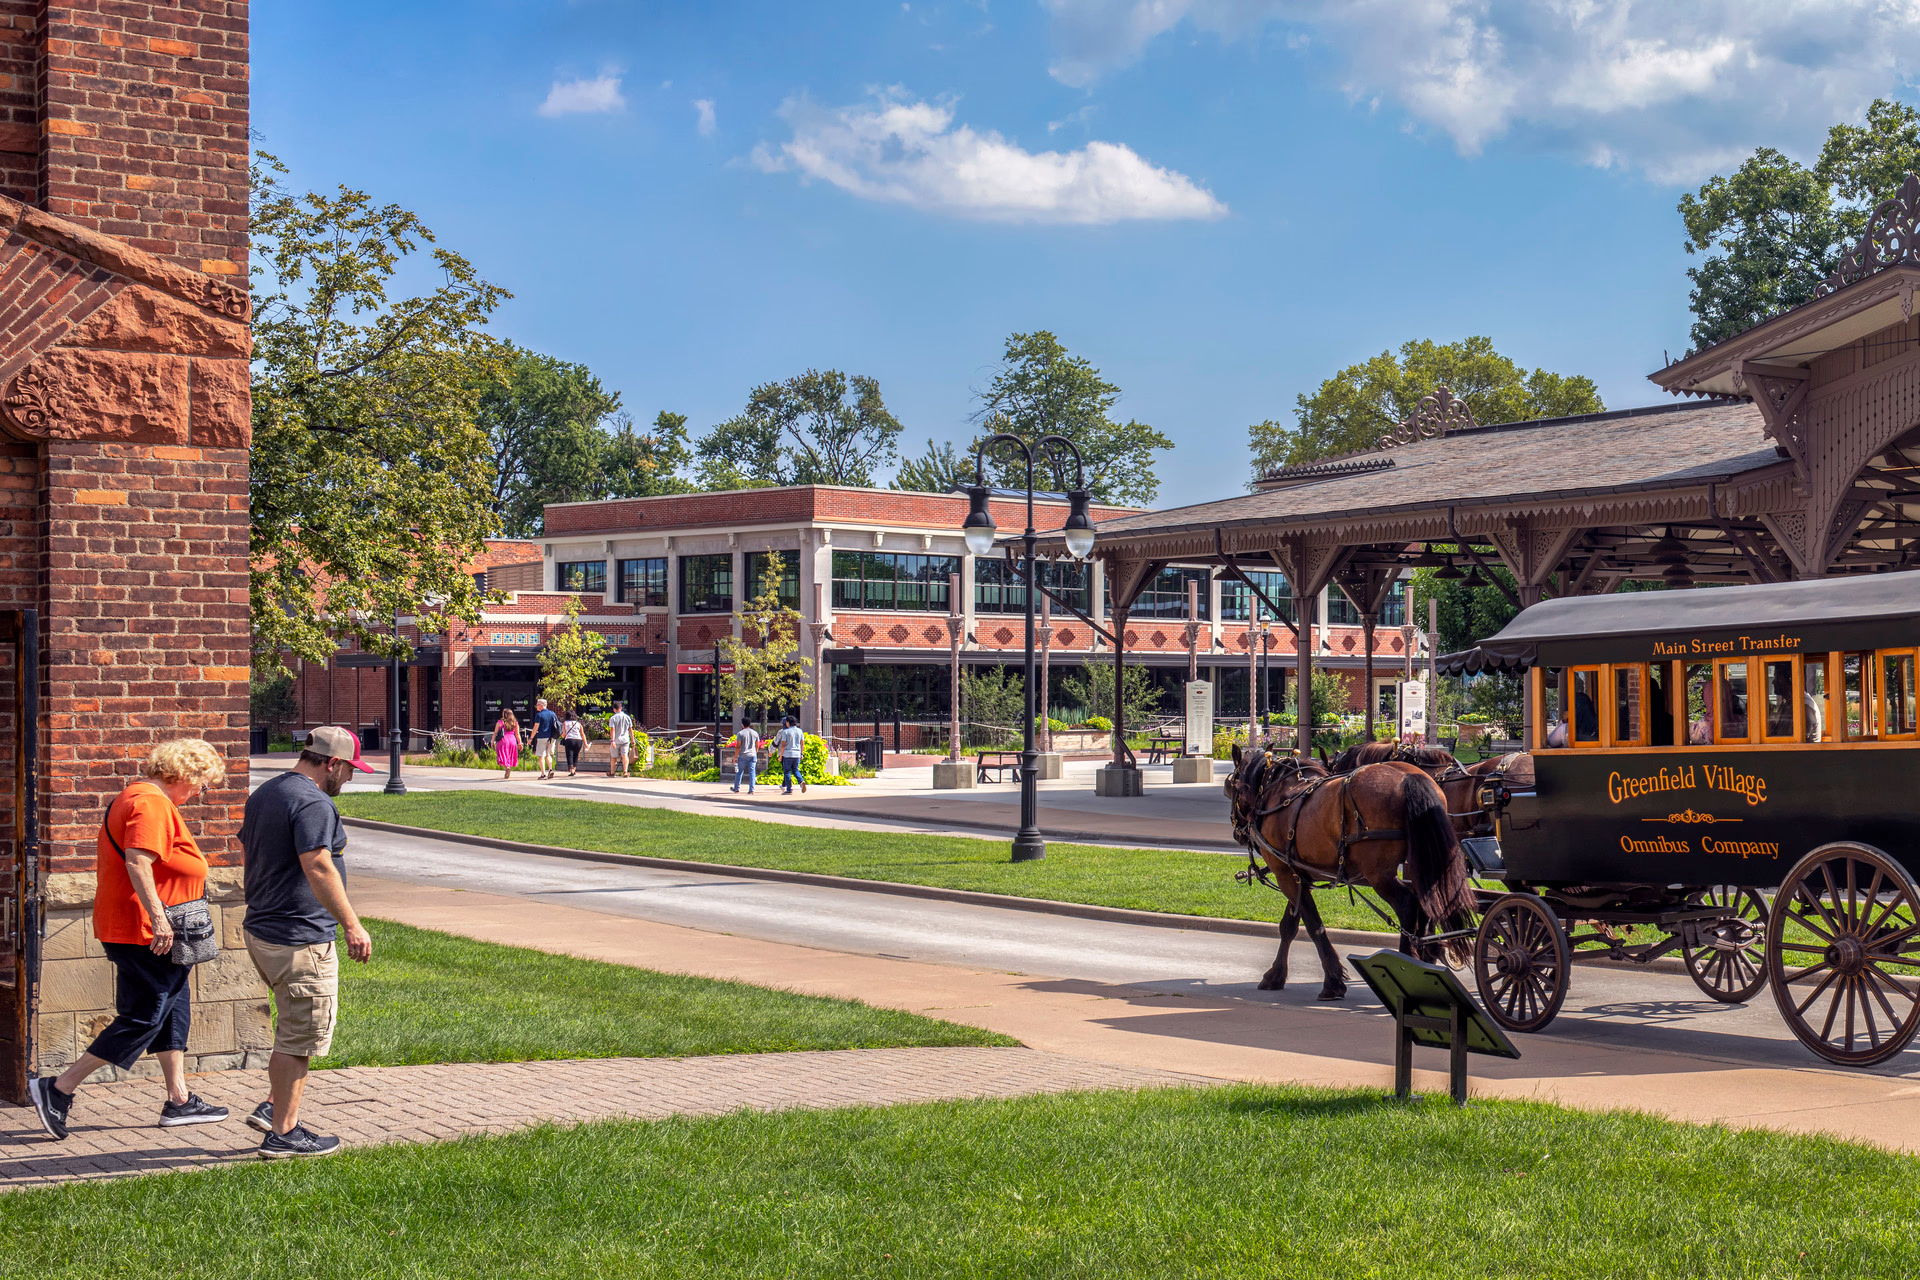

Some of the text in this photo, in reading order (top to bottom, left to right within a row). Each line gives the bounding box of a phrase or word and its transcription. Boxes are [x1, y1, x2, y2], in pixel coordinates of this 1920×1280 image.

[1653, 634, 1801, 656] Main Street Transfer
[1608, 765, 1768, 806] Greenfield Village
[1620, 835, 1779, 860] Omnibus Company
